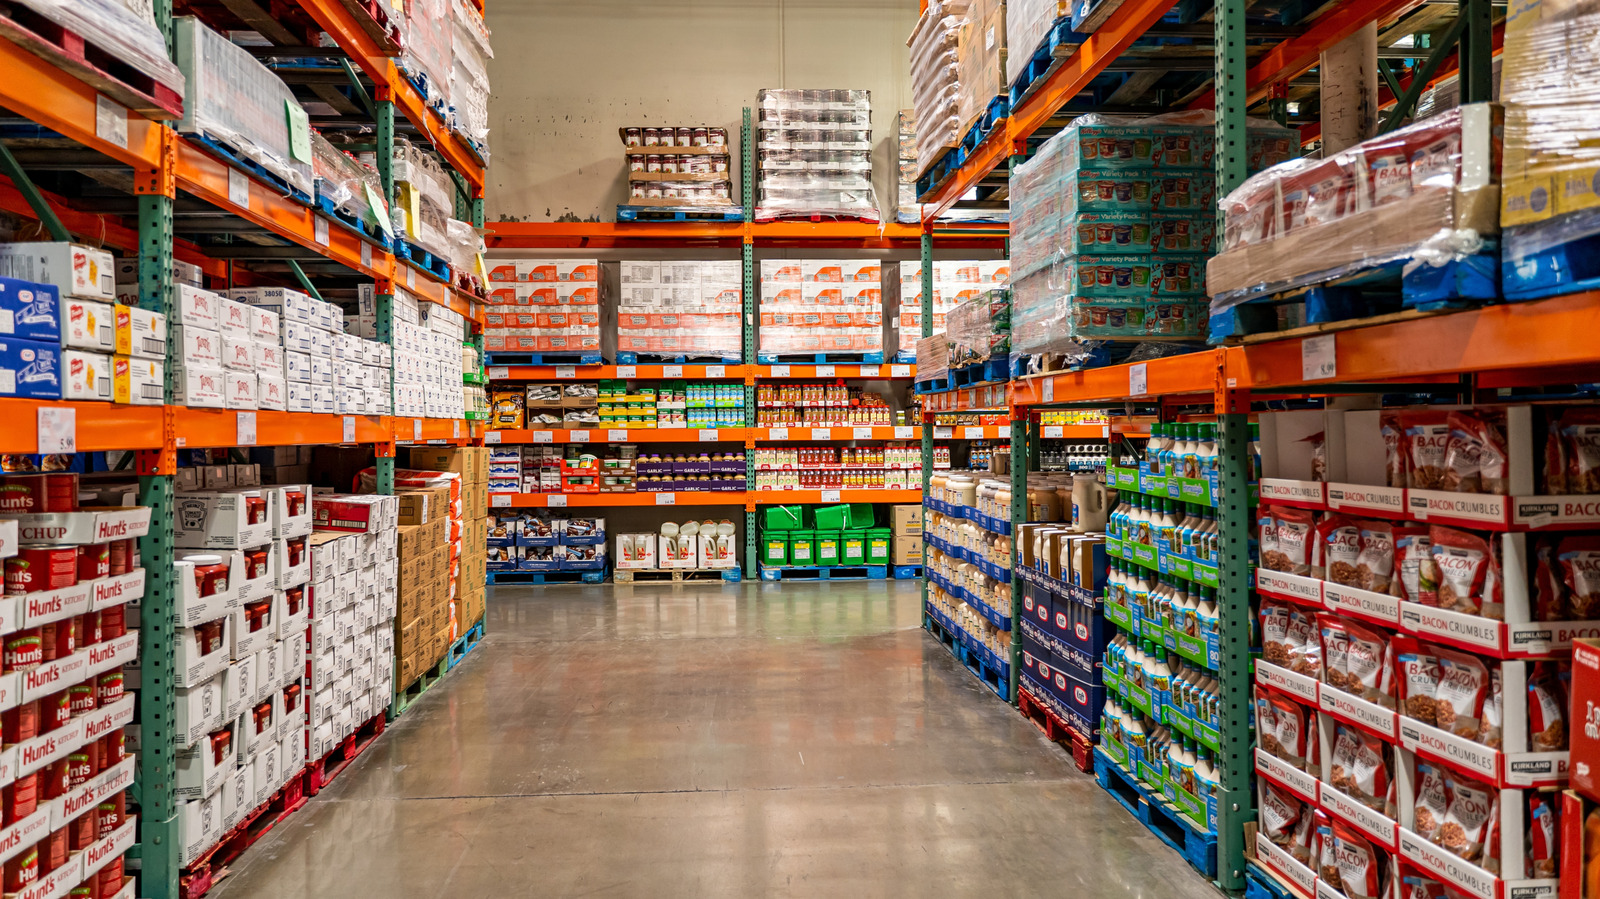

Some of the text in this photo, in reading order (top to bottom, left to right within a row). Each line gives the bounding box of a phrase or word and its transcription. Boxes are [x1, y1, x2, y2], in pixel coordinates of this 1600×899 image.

[60, 437, 74, 450] 5.99
[1274, 485, 1320, 498] BACON CRUMBLES
[1345, 492, 1400, 506] BACON CRUMBLES
[1429, 499, 1500, 516] BACON CRUMBLES
[99, 520, 127, 538] Hunt's
[1160, 555, 1166, 566] 80
[1434, 555, 1474, 571] BACON
[96, 580, 122, 601] Hunt's
[1272, 580, 1318, 598] BACON CRUMBLES
[29, 595, 62, 618] Hunt's
[1340, 595, 1397, 617] BACON CRUMBLES
[1133, 618, 1140, 628] 80
[1421, 616, 1494, 641] BACON CRUMBLES
[89, 643, 115, 666] Hunt's
[1210, 651, 1219, 661] 80
[27, 664, 60, 690] Hunt's
[1269, 672, 1314, 697] BACON CRUMBLES
[1445, 668, 1478, 689] BACON
[1154, 704, 1160, 713] 80
[1335, 699, 1392, 731] BACON CRUMBLES
[86, 714, 112, 739] Hunt's
[23, 737, 55, 766] Hunt's
[1420, 734, 1492, 770] BACON CRUMBLES
[1269, 763, 1313, 794] BACON CRUMBLES
[63, 786, 94, 818] Hunt's
[97, 770, 128, 799] KETCHUP
[1264, 796, 1291, 821] BACON
[23, 816, 46, 836] KETCHUP
[1336, 801, 1392, 839] BACON CRUMBLES
[88, 837, 114, 866] Hunt's
[1336, 849, 1366, 869] BACON
[1269, 850, 1314, 889] BACON CRUMBLES
[1420, 850, 1492, 897] BACON CRUMBLES
[23, 877, 55, 899] Hunt's
[1512, 888, 1550, 896] KIRKLAND
